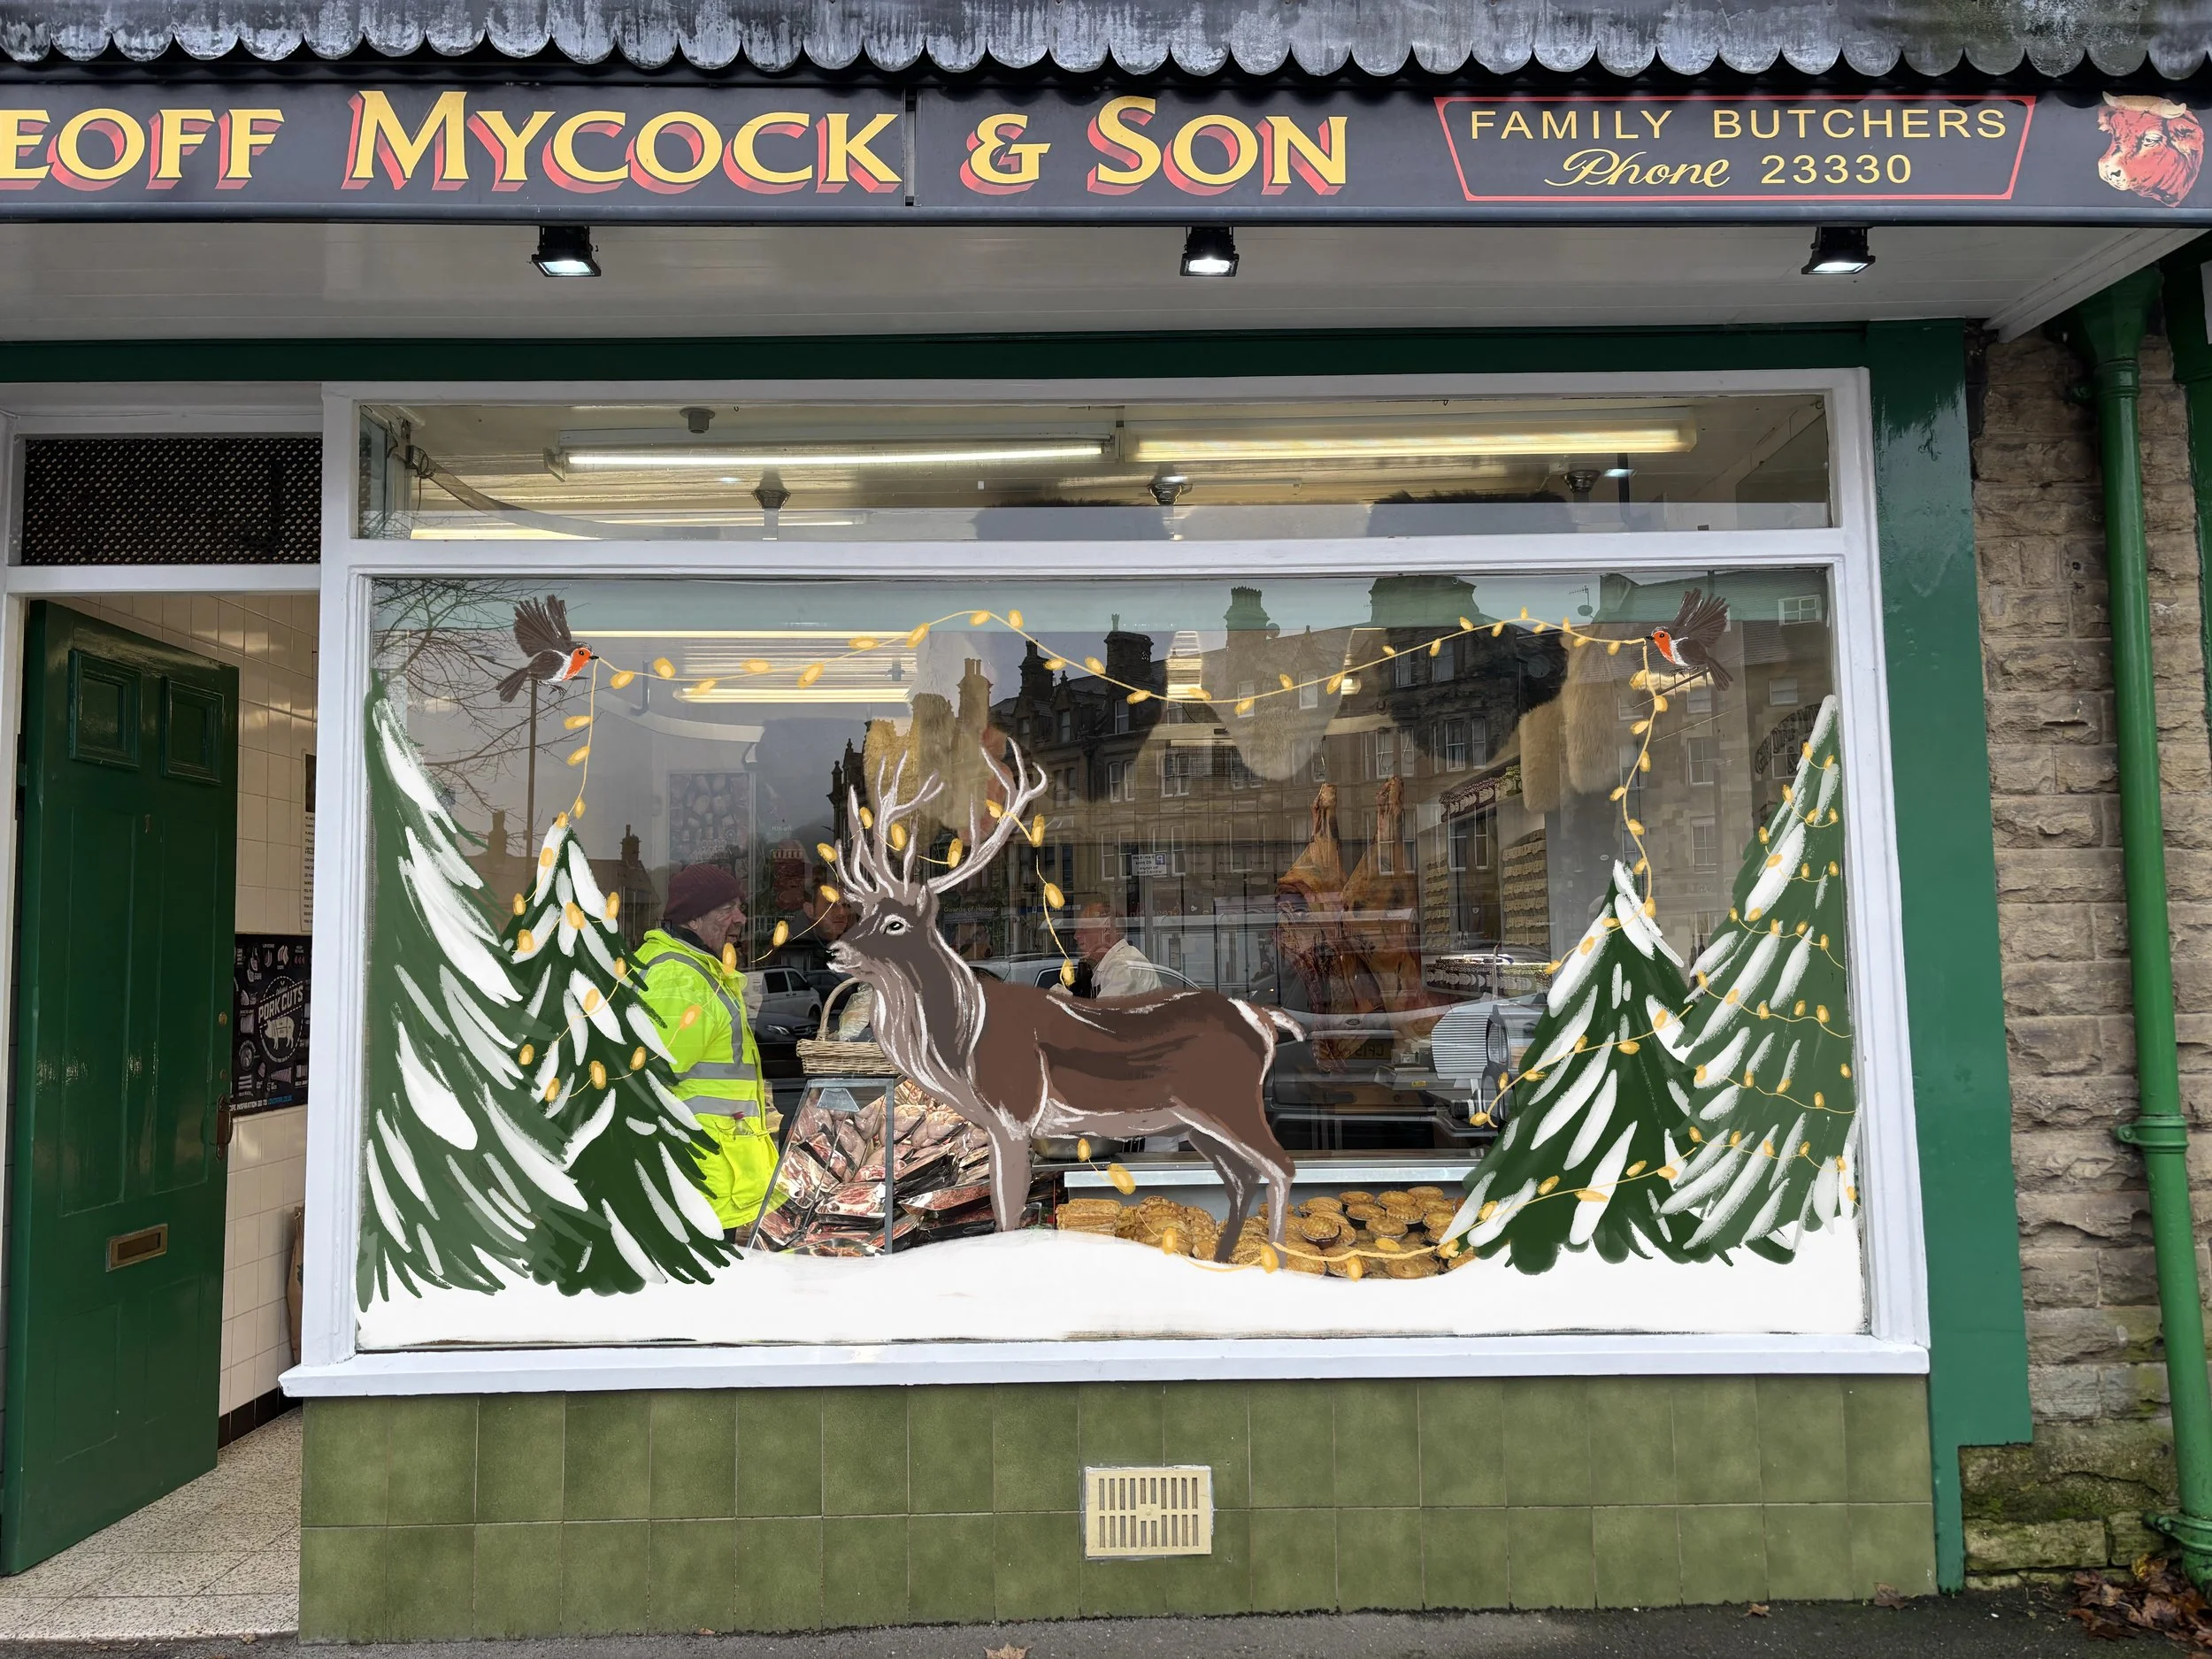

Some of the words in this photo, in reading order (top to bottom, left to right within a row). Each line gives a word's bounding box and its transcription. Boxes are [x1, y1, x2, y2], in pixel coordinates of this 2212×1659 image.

[1471, 109, 1674, 141] FAMILY
[1712, 108, 2008, 140] BUTCHERS
[959, 113, 1051, 196] &
[1543, 147, 1731, 188] Phone
[1760, 153, 1913, 185] 23330
[258, 996, 280, 1024] PORK
[281, 985, 303, 1011] CUTS
